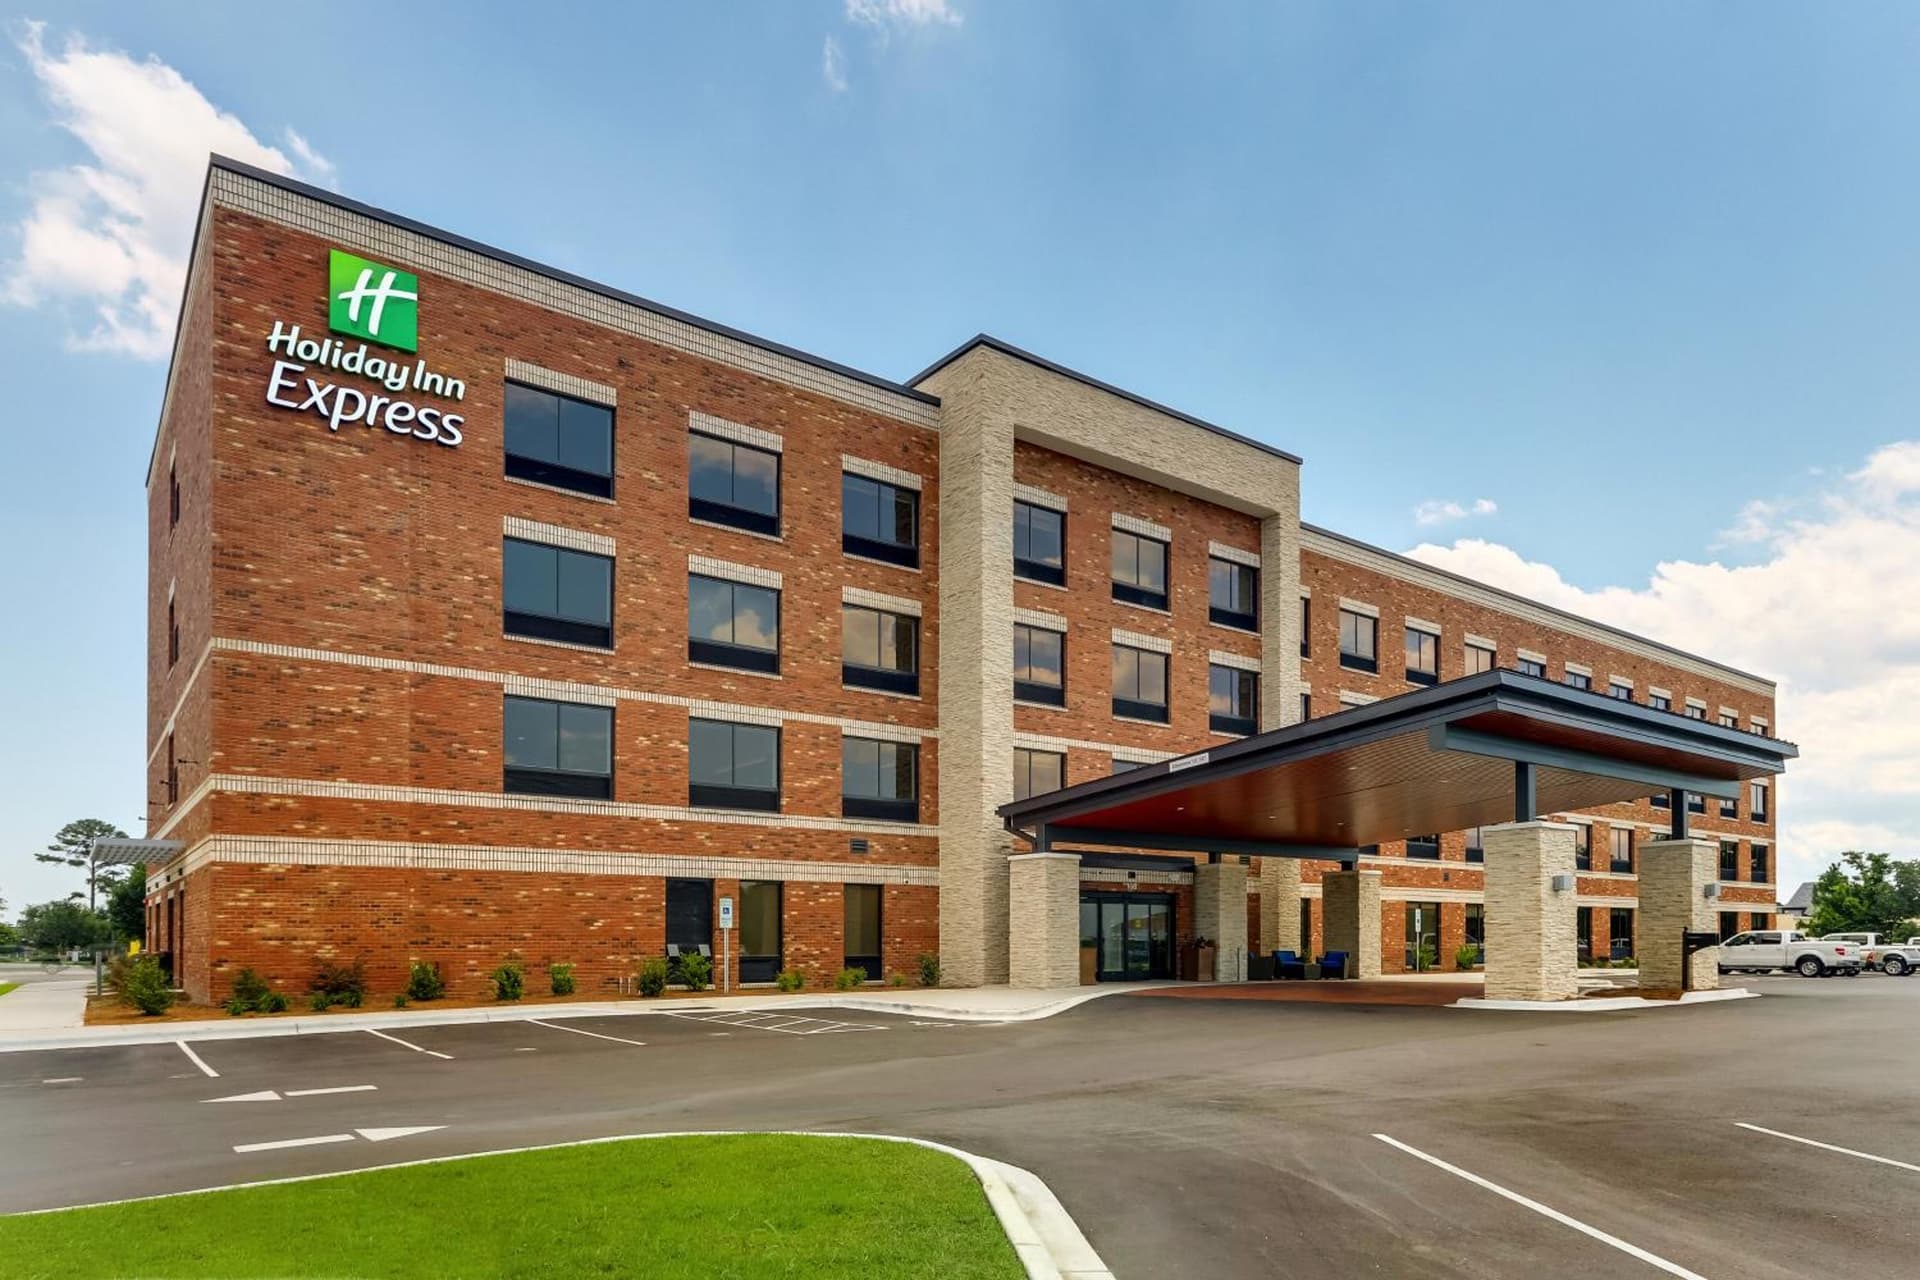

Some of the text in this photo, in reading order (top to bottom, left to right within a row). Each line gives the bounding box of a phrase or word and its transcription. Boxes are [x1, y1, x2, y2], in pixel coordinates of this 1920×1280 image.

[338, 269, 417, 336] H
[266, 321, 466, 400] Holiday Inn
[266, 360, 465, 446] Express
